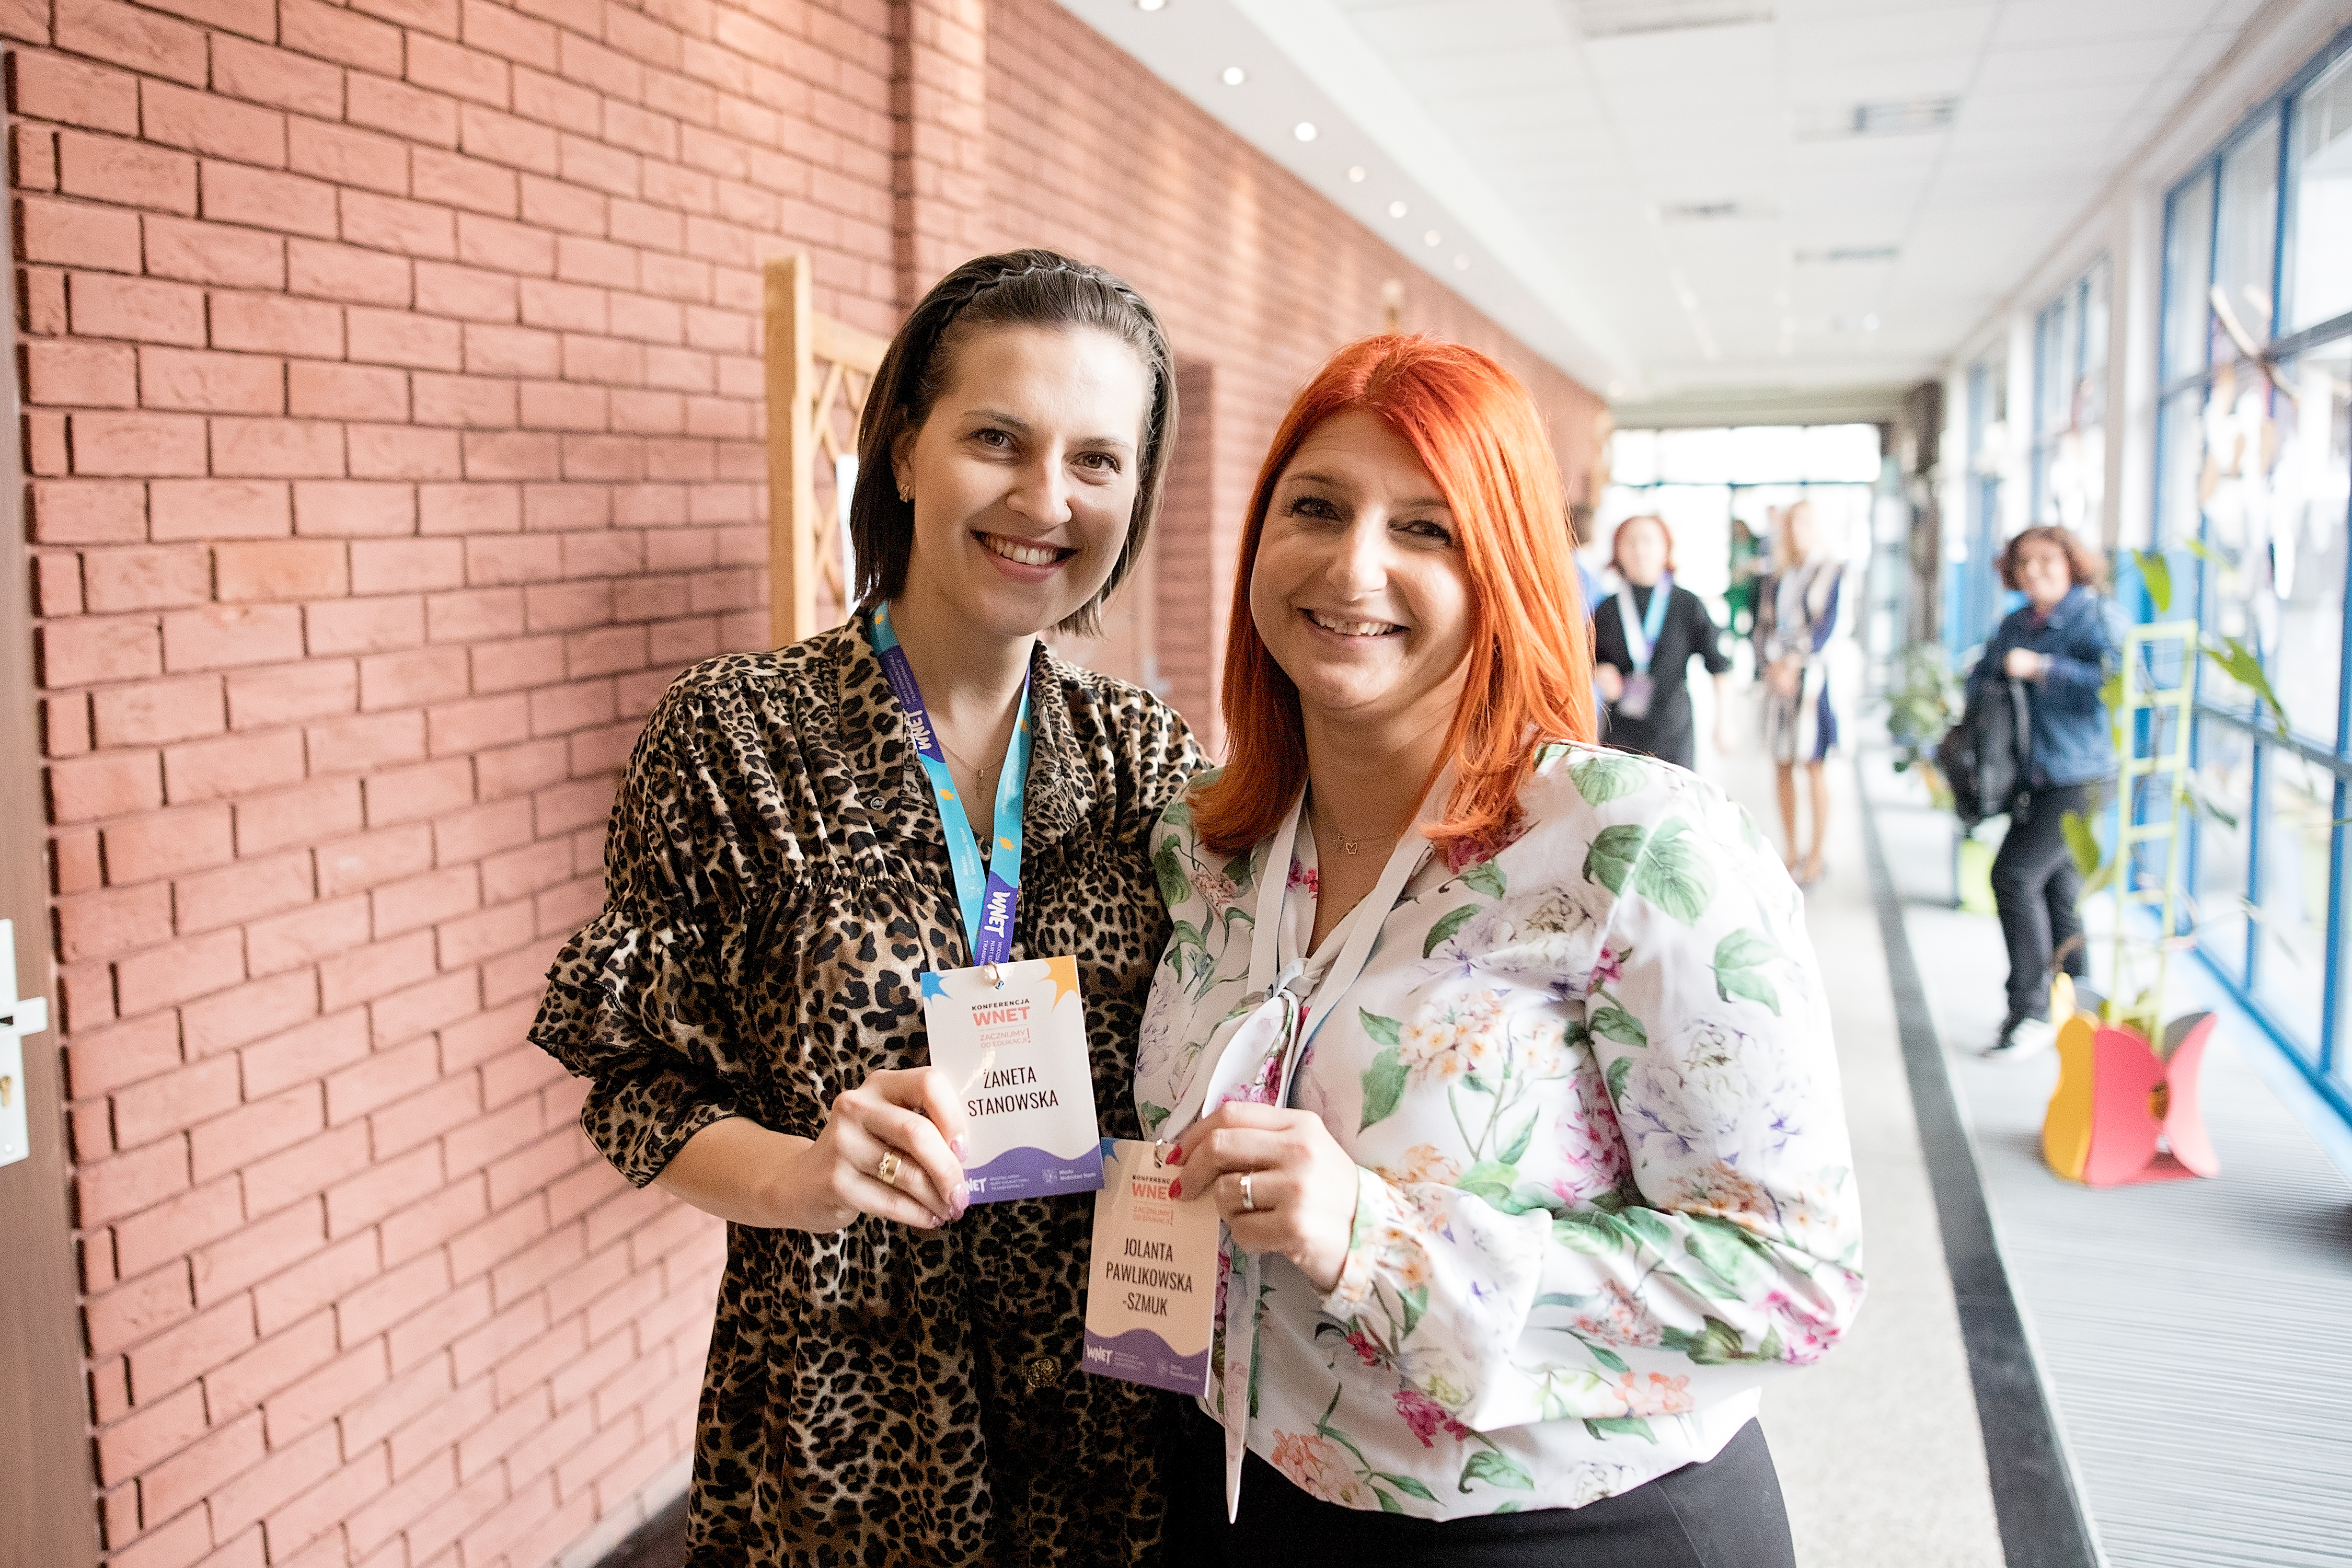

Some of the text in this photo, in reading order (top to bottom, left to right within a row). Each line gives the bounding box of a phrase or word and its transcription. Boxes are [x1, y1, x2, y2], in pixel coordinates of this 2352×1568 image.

[908, 710, 932, 750] WNET
[984, 891, 1011, 938] WNET
[972, 998, 1030, 1011] KONFERENCJA
[973, 1006, 1030, 1027] WNET
[979, 1030, 1026, 1041] ZACZNIJMY
[968, 1089, 1059, 1117] STANOWSKA
[1132, 1182, 1167, 1201] WNE
[1124, 1237, 1173, 1262] JOLANTA
[1106, 1261, 1193, 1293] PAWLIKOWSKA
[1122, 1292, 1168, 1317] -SZMUK
[1086, 1344, 1113, 1365] WNET
